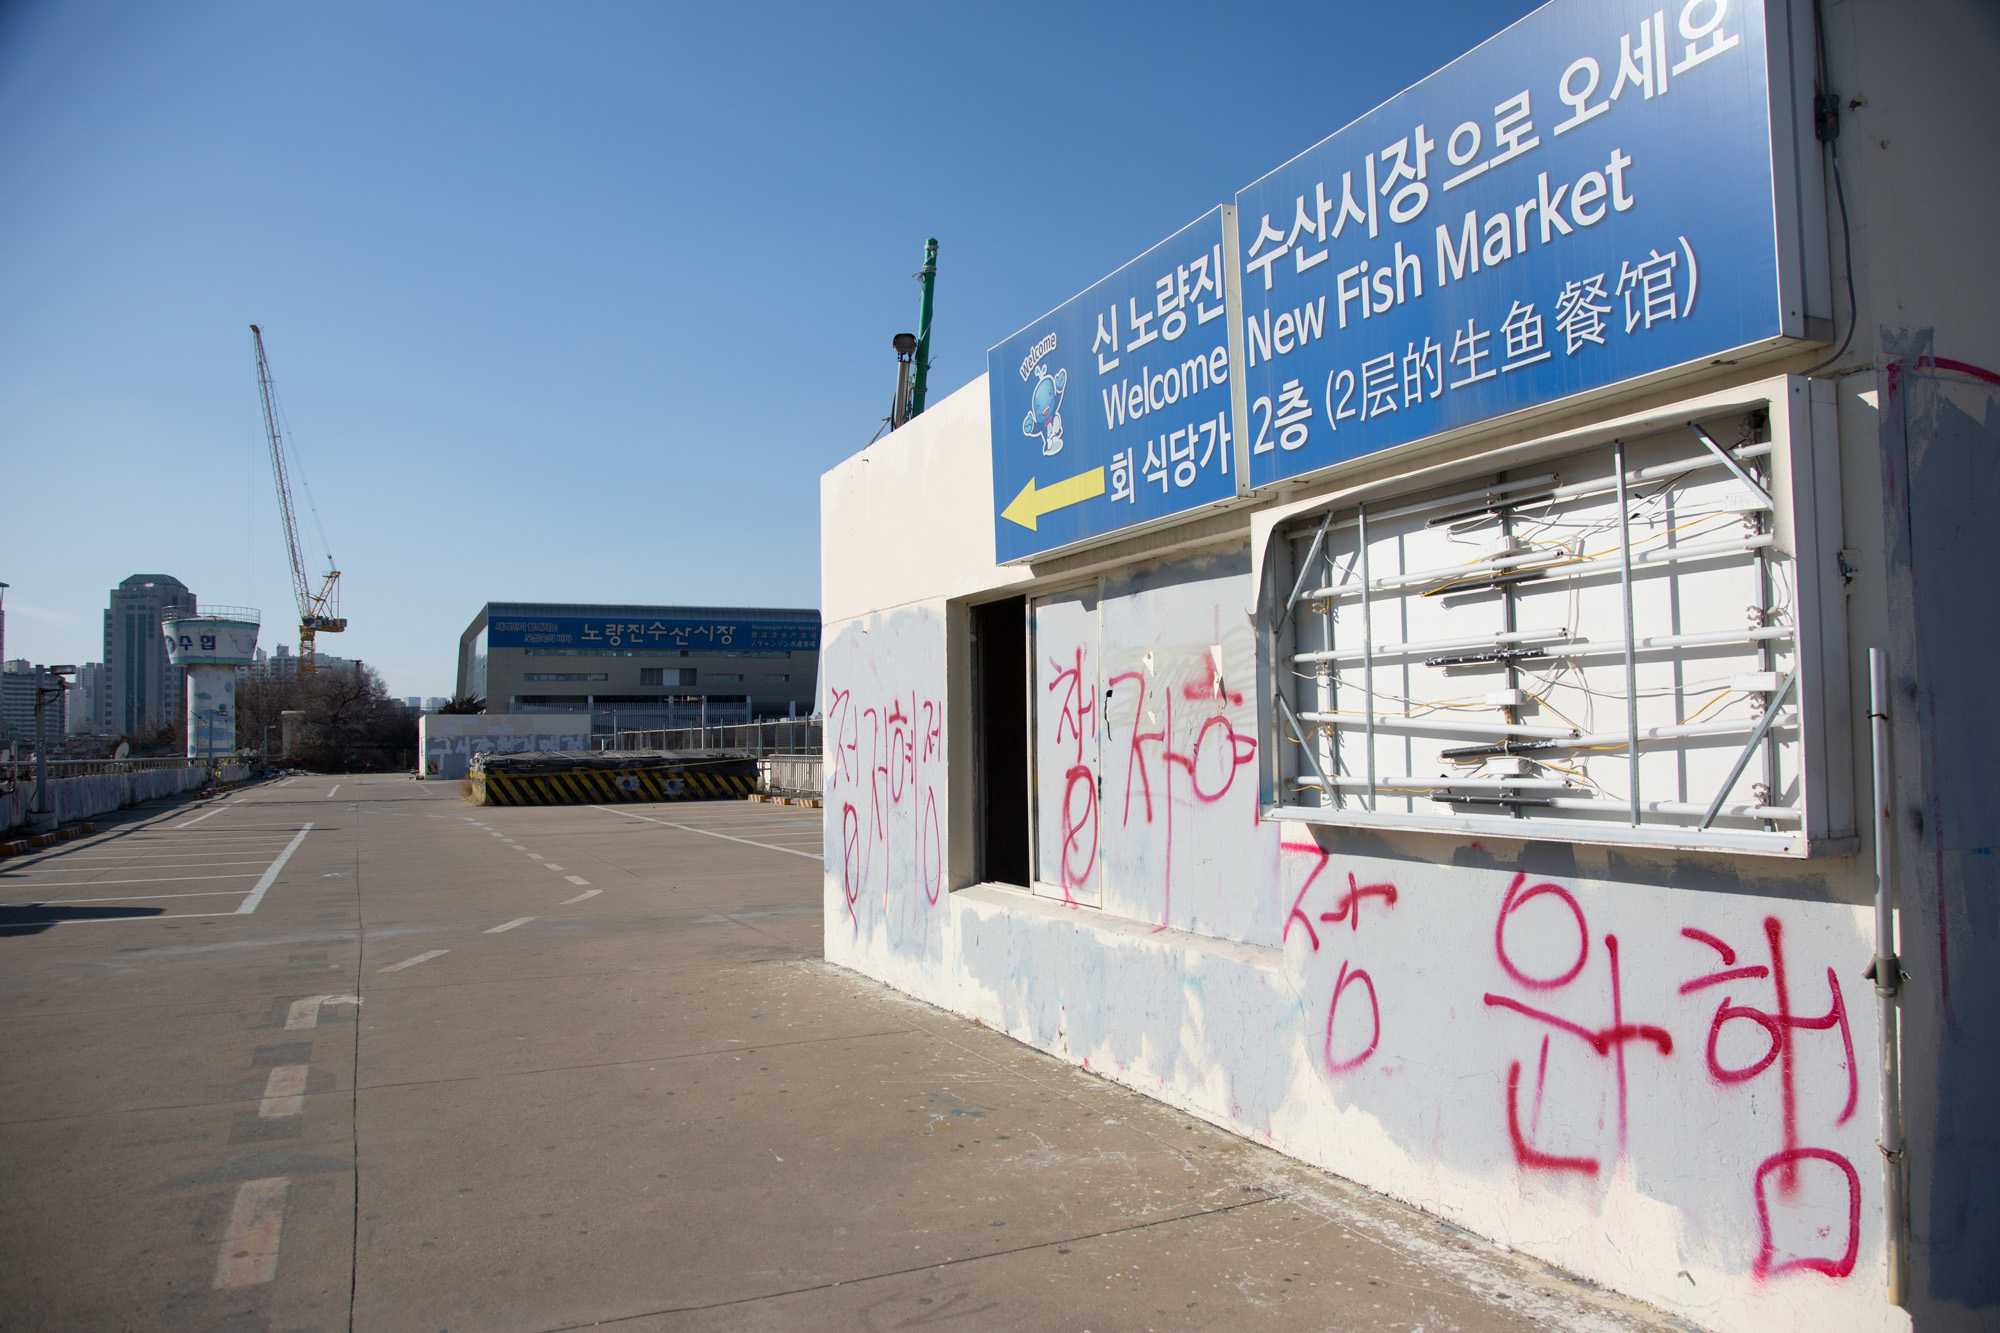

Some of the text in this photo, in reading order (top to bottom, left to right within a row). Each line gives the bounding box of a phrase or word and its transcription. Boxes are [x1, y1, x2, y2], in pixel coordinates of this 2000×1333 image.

[1091, 0, 1739, 375] 신 노량진 수산시장으로 오세요
[1019, 332, 1058, 381] Welcome
[1102, 148, 1635, 430] Welcome New Fish Market
[1110, 235, 1698, 504] 회 식당가 2층 (2层的生鱼餐馆)
[179, 635, 216, 651] 수협
[581, 621, 737, 646] 노량진수산시장
